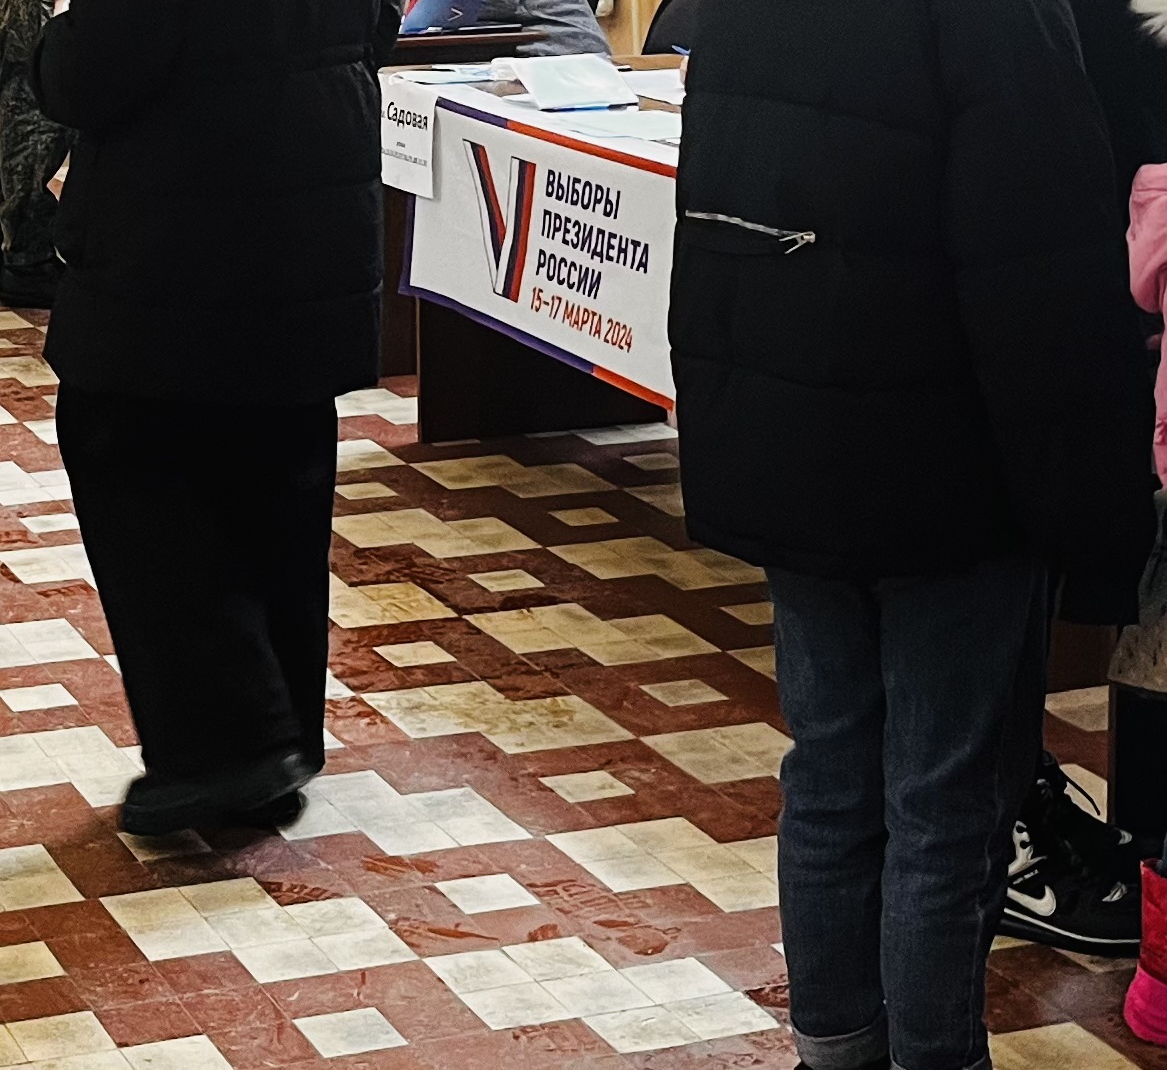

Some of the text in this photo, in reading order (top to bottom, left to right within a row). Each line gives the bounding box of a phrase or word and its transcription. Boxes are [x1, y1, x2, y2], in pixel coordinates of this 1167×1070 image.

[387, 101, 428, 130] Садовая
[545, 169, 621, 220] ВЫБОРЫ
[541, 208, 649, 274] ПРЕЗИДЕНТА
[535, 248, 602, 299] РОССИИ
[562, 299, 602, 340] МАРТА
[603, 317, 633, 353] 2024
